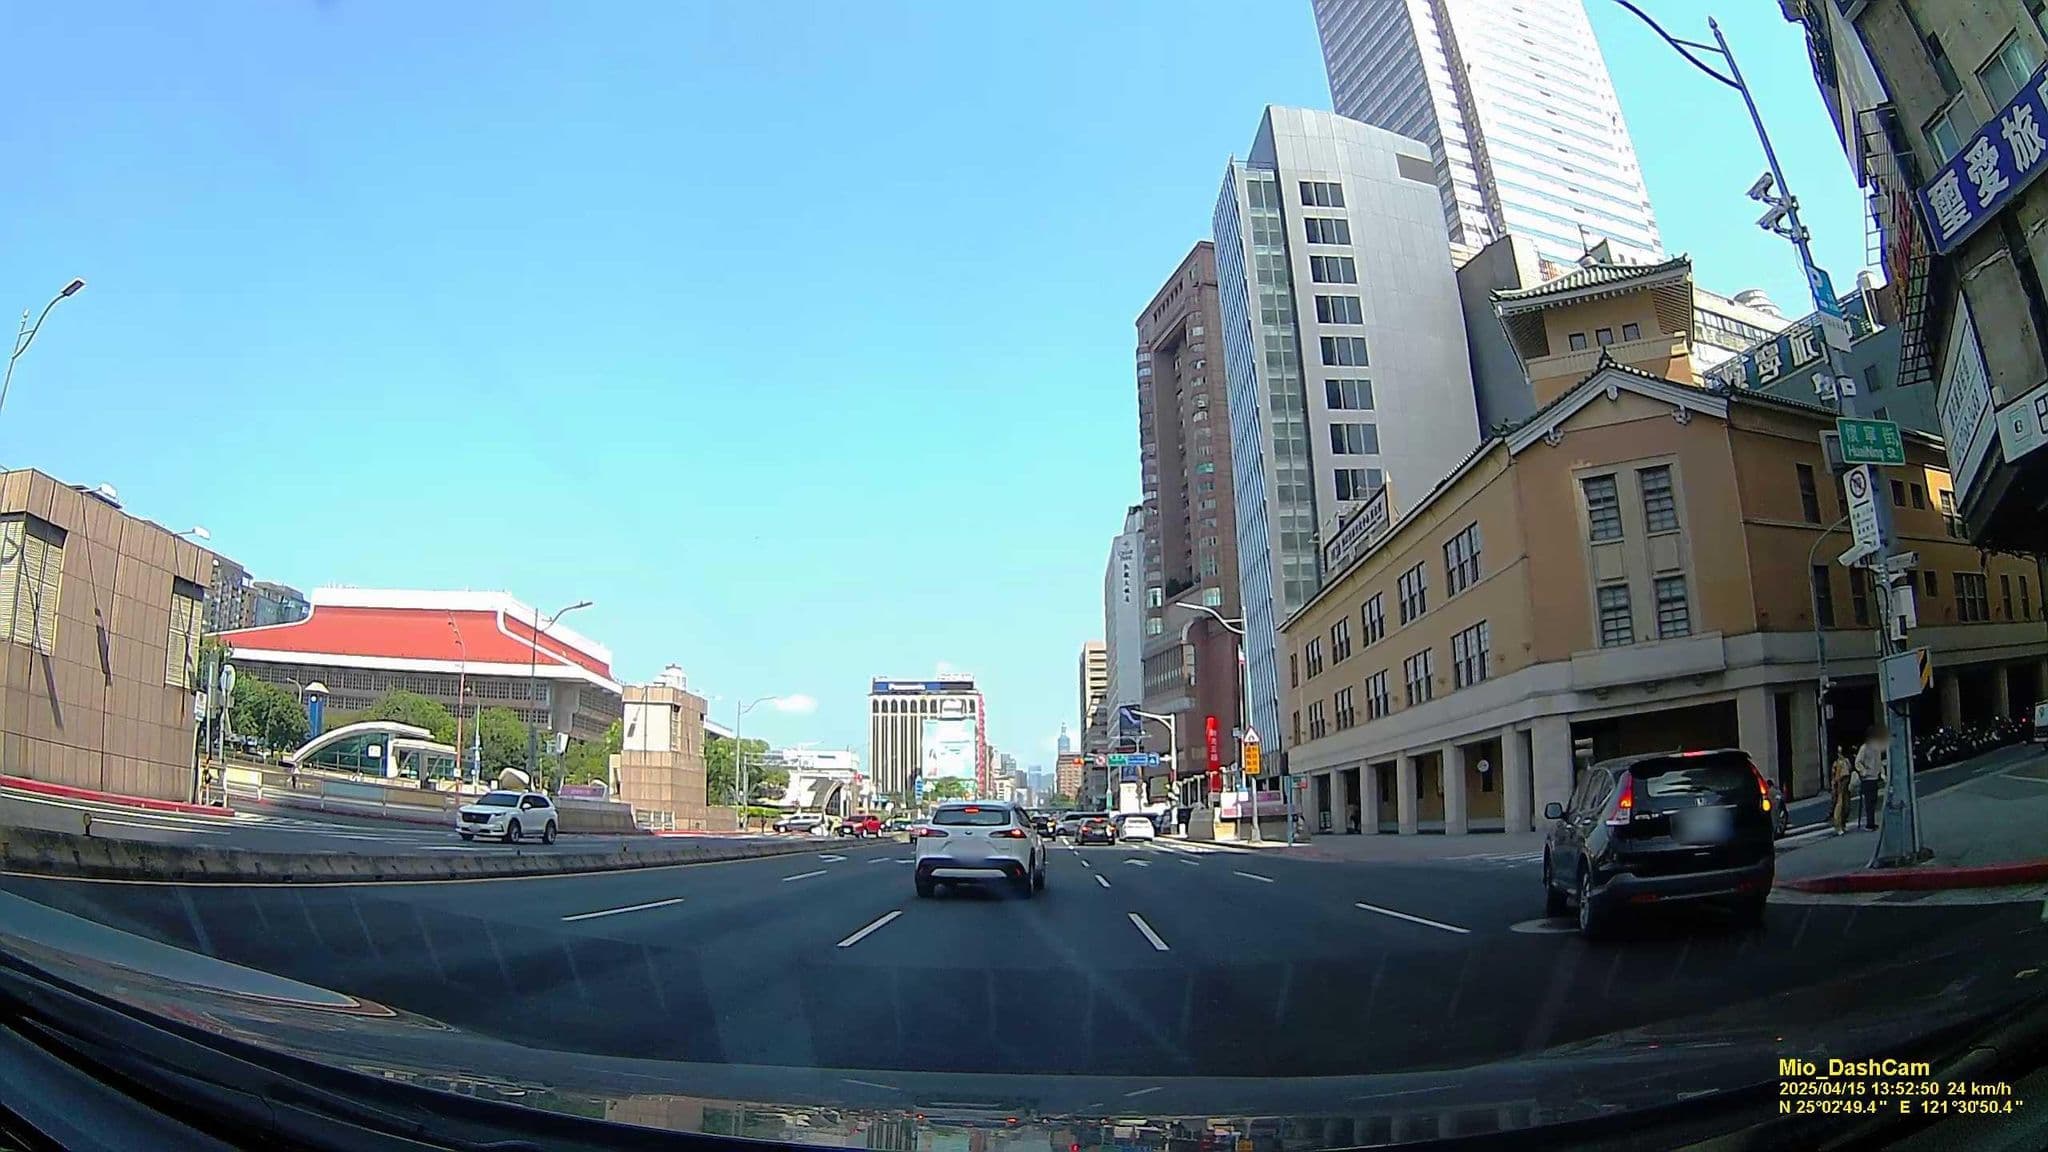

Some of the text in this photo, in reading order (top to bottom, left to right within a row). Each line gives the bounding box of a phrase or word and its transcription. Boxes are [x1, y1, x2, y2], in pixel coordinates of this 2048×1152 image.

[1927, 70, 2048, 241] 聖愛旅
[1844, 423, 1900, 448] 懷寧街
[1847, 443, 1885, 462] HuaiNing
